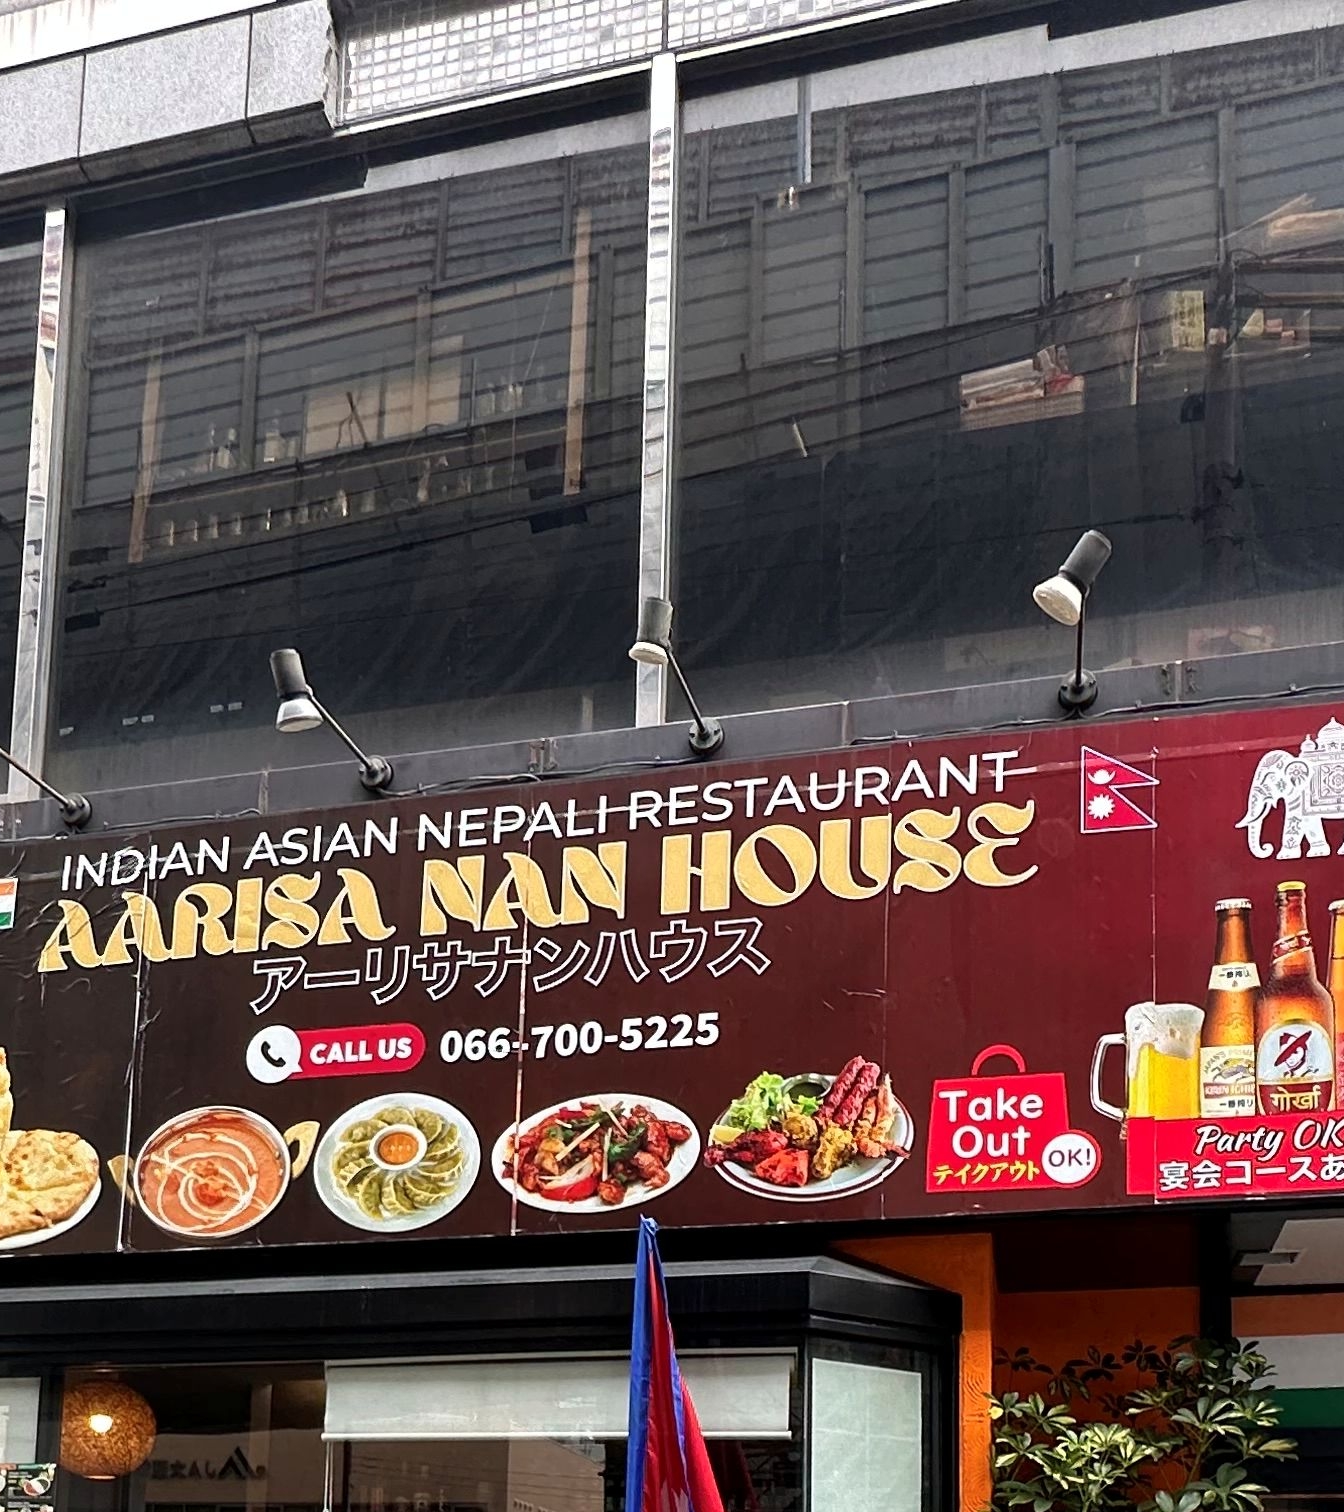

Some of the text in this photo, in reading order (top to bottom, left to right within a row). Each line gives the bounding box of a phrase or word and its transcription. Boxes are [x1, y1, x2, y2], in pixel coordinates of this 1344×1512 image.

[60, 750, 1020, 892] INDIAN ASIAN NEPALI RESTAURANT
[37, 799, 1040, 972] AARISA NAN HOUSE
[249, 916, 772, 1016] アーリサナンハウス
[308, 1037, 413, 1066] CALL US
[440, 1011, 721, 1064] 066-700-5225
[938, 1087, 1045, 1123] Take
[951, 1126, 1032, 1160] Out
[1047, 1147, 1092, 1170] OK!
[1194, 1125, 1283, 1163] Party
[932, 1163, 1041, 1187] テイクアウト
